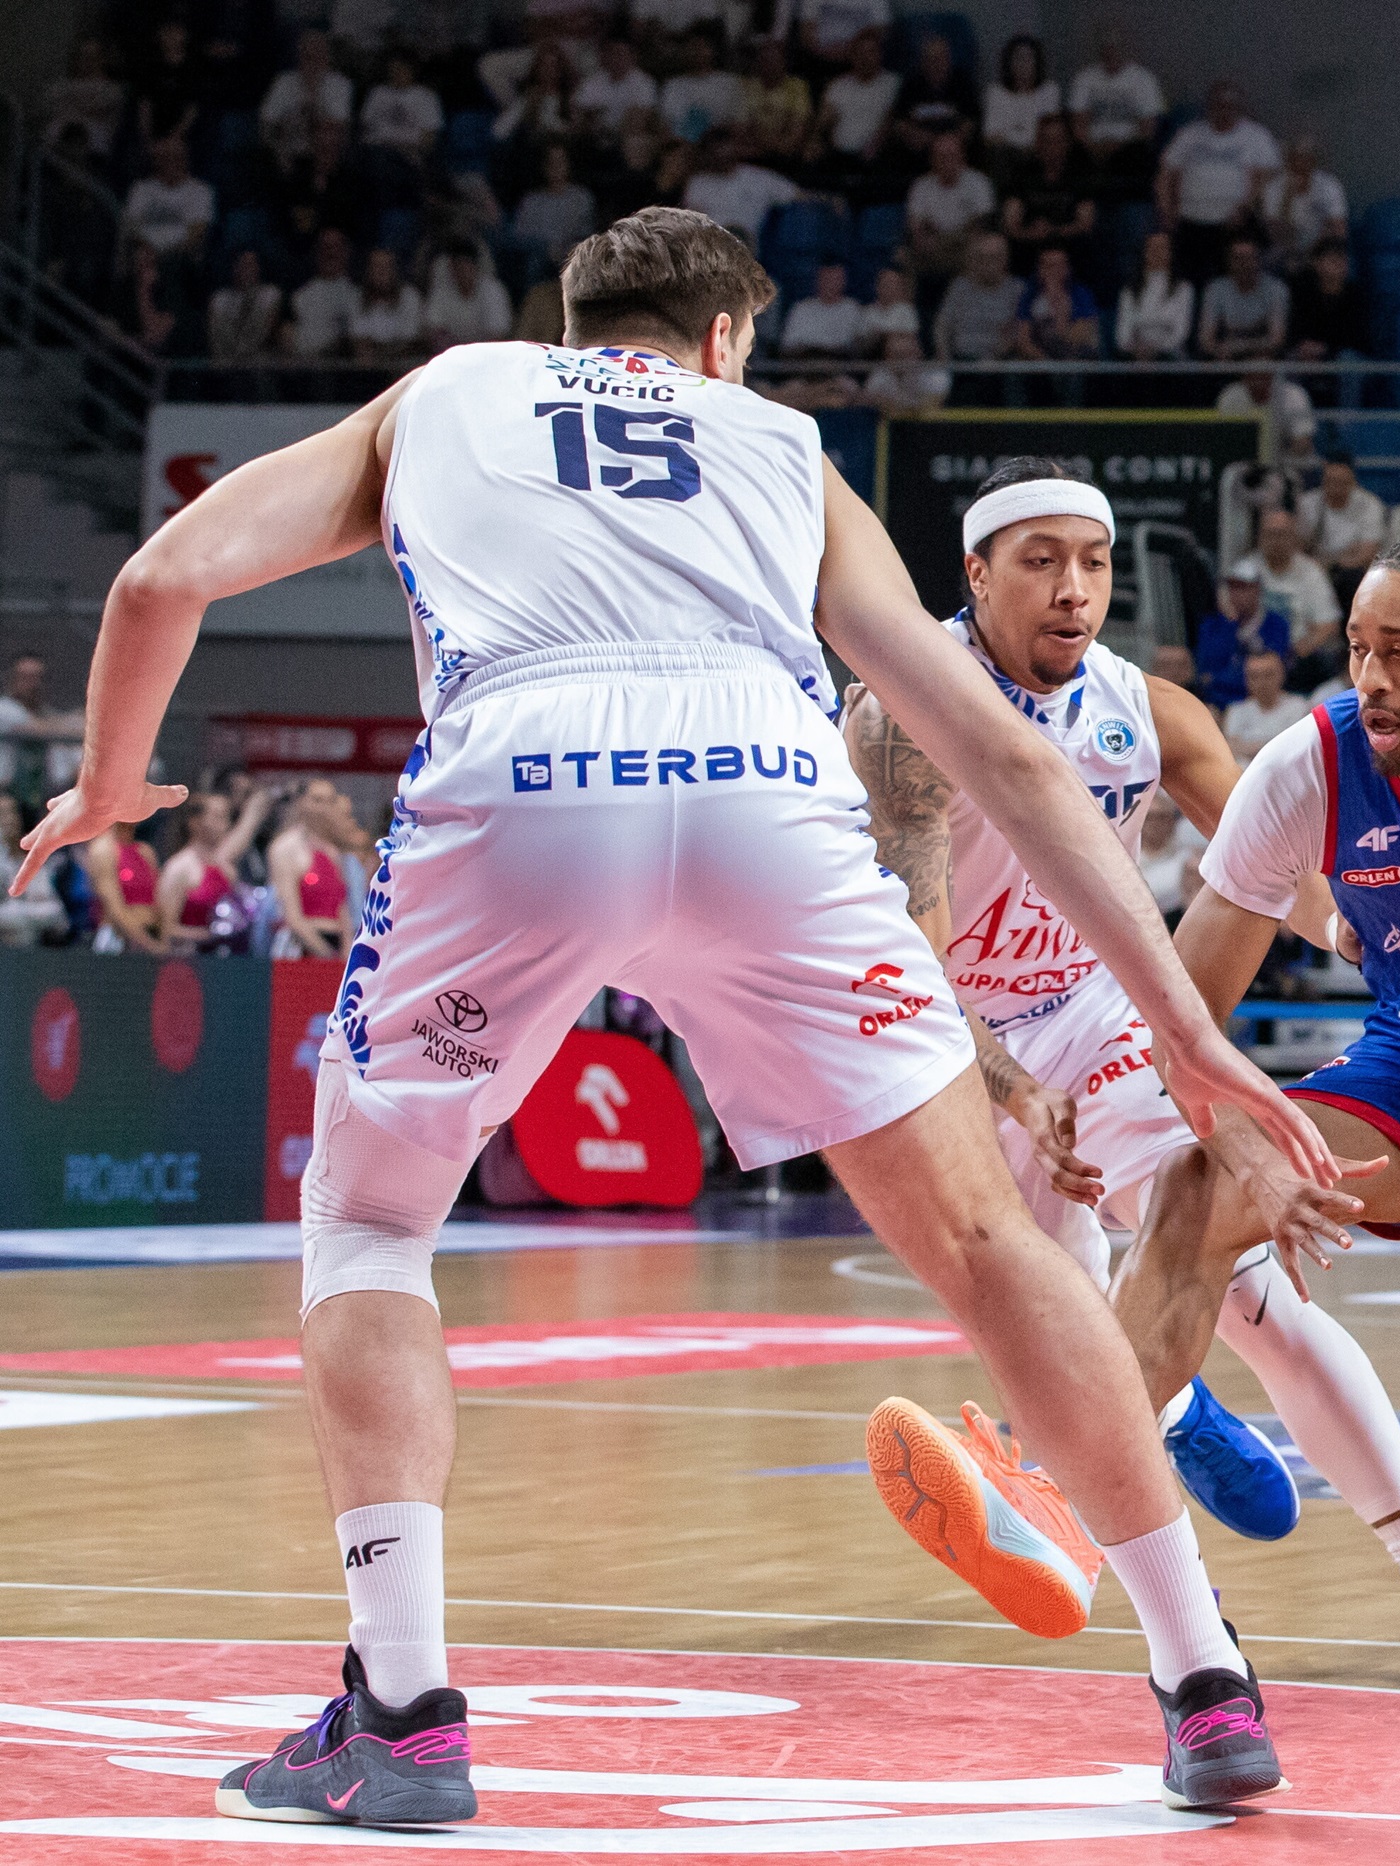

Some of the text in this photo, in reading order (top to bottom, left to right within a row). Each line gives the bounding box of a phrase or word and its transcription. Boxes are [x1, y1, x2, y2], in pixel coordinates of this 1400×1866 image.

[534, 402, 702, 503] 15
[1103, 455, 1213, 483] CONTI
[561, 744, 818, 788] TERBUD
[1356, 824, 1400, 852] 4F
[1347, 871, 1396, 884] ORLEN
[411, 1019, 499, 1074] JAWORSKI
[1087, 1048, 1153, 1096] ORLE
